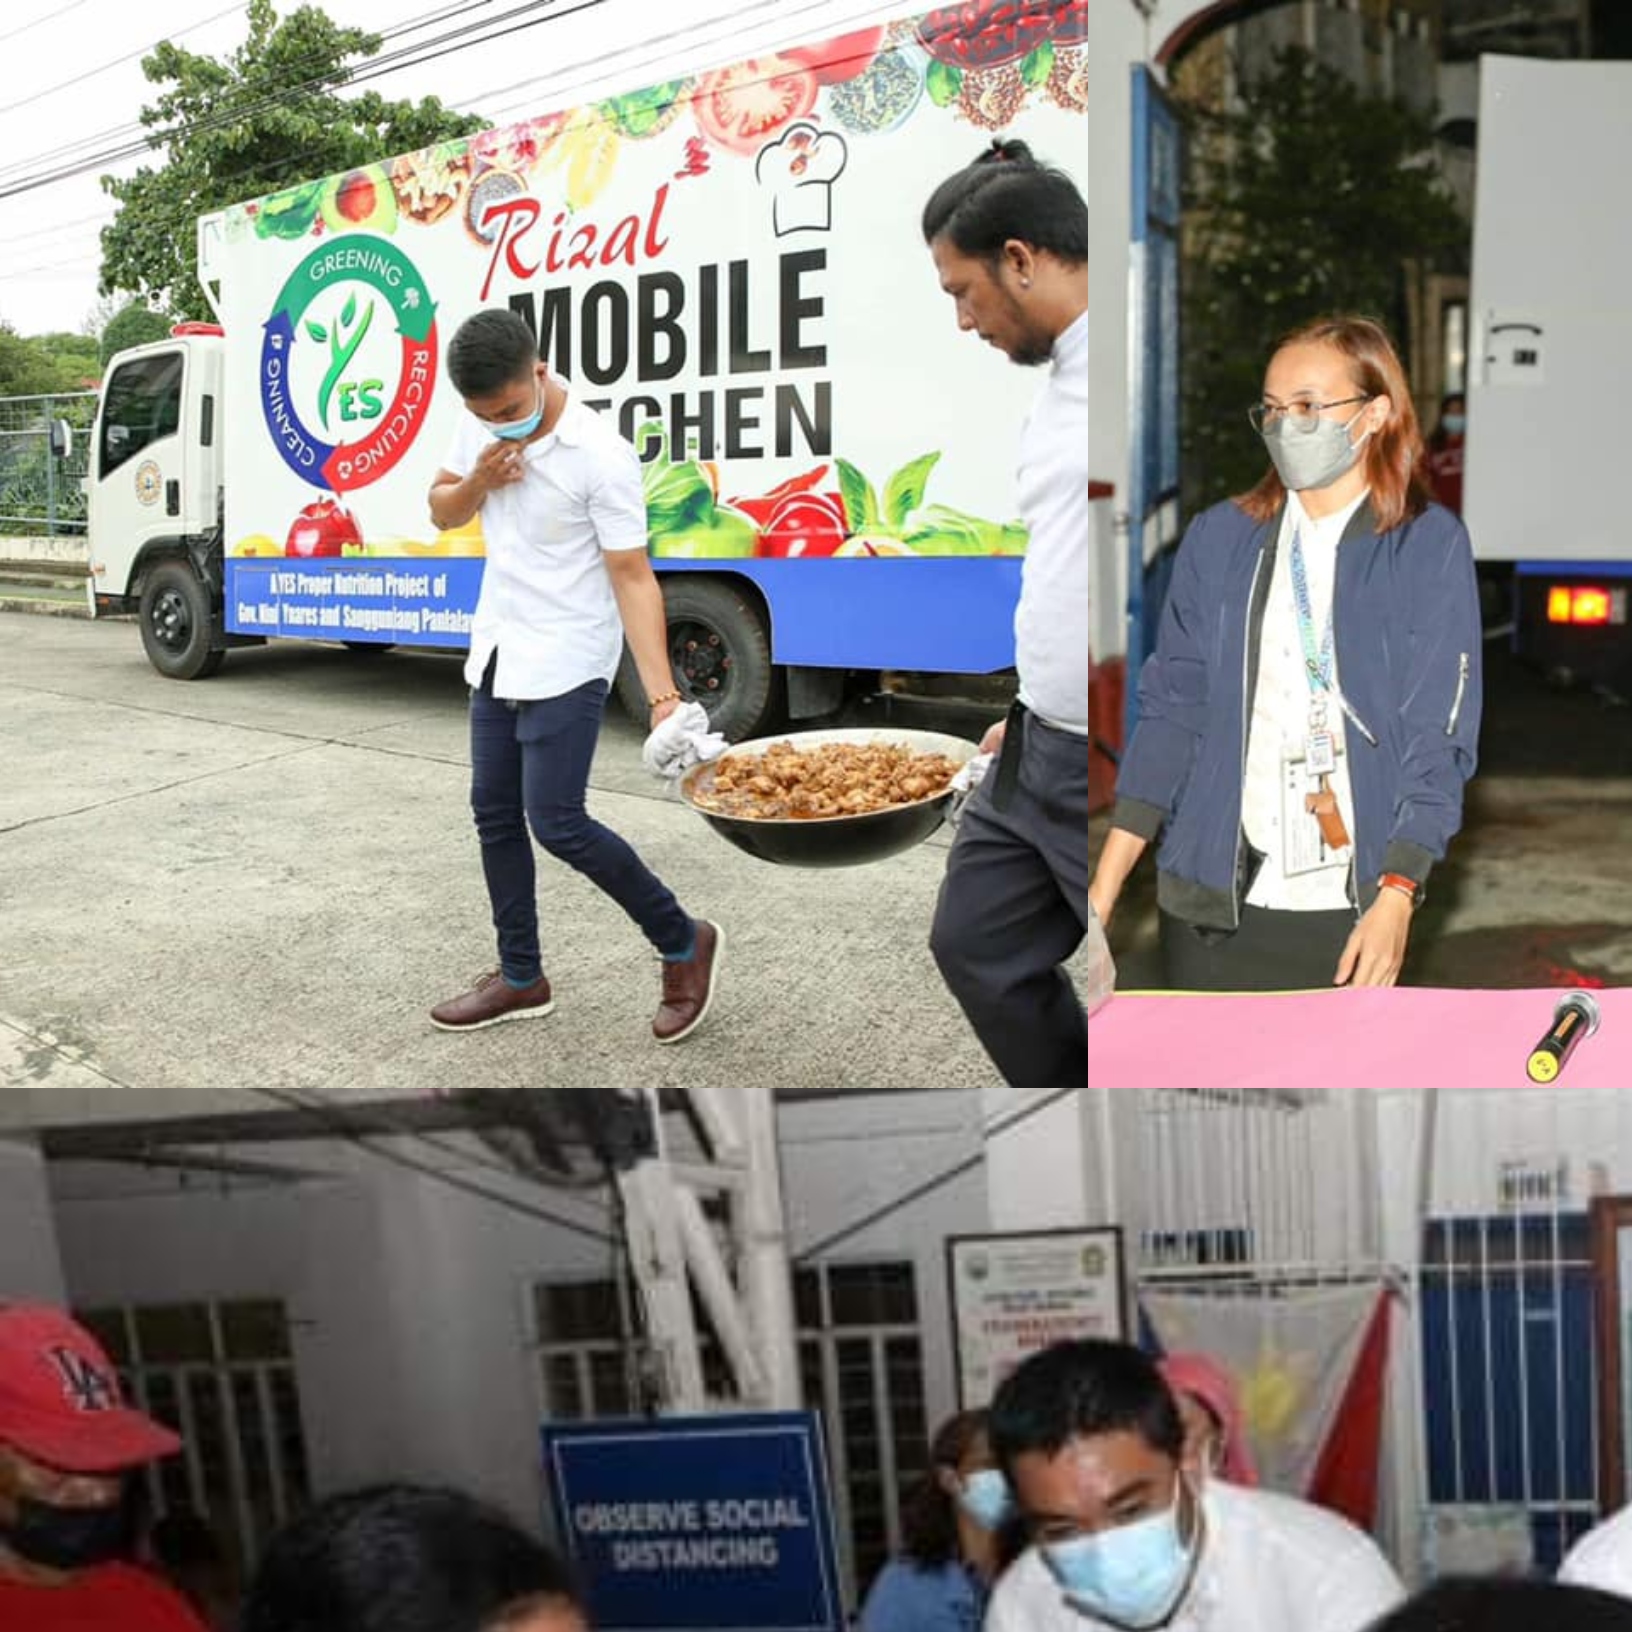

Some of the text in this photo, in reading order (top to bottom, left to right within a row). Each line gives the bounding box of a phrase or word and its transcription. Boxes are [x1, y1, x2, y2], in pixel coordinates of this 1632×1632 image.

[310, 249, 403, 287] GREENING
[480, 183, 669, 301] Rizal
[508, 248, 828, 386] MOBILE
[267, 358, 316, 466] CLEANING
[354, 349, 429, 473] RECYCLING
[580, 381, 832, 463] CHEN
[385, 573, 429, 599] Project
[433, 573, 447, 597] of
[574, 1499, 810, 1533] OBSERVE SOCIAL
[613, 1536, 780, 1570] DISTANCING
